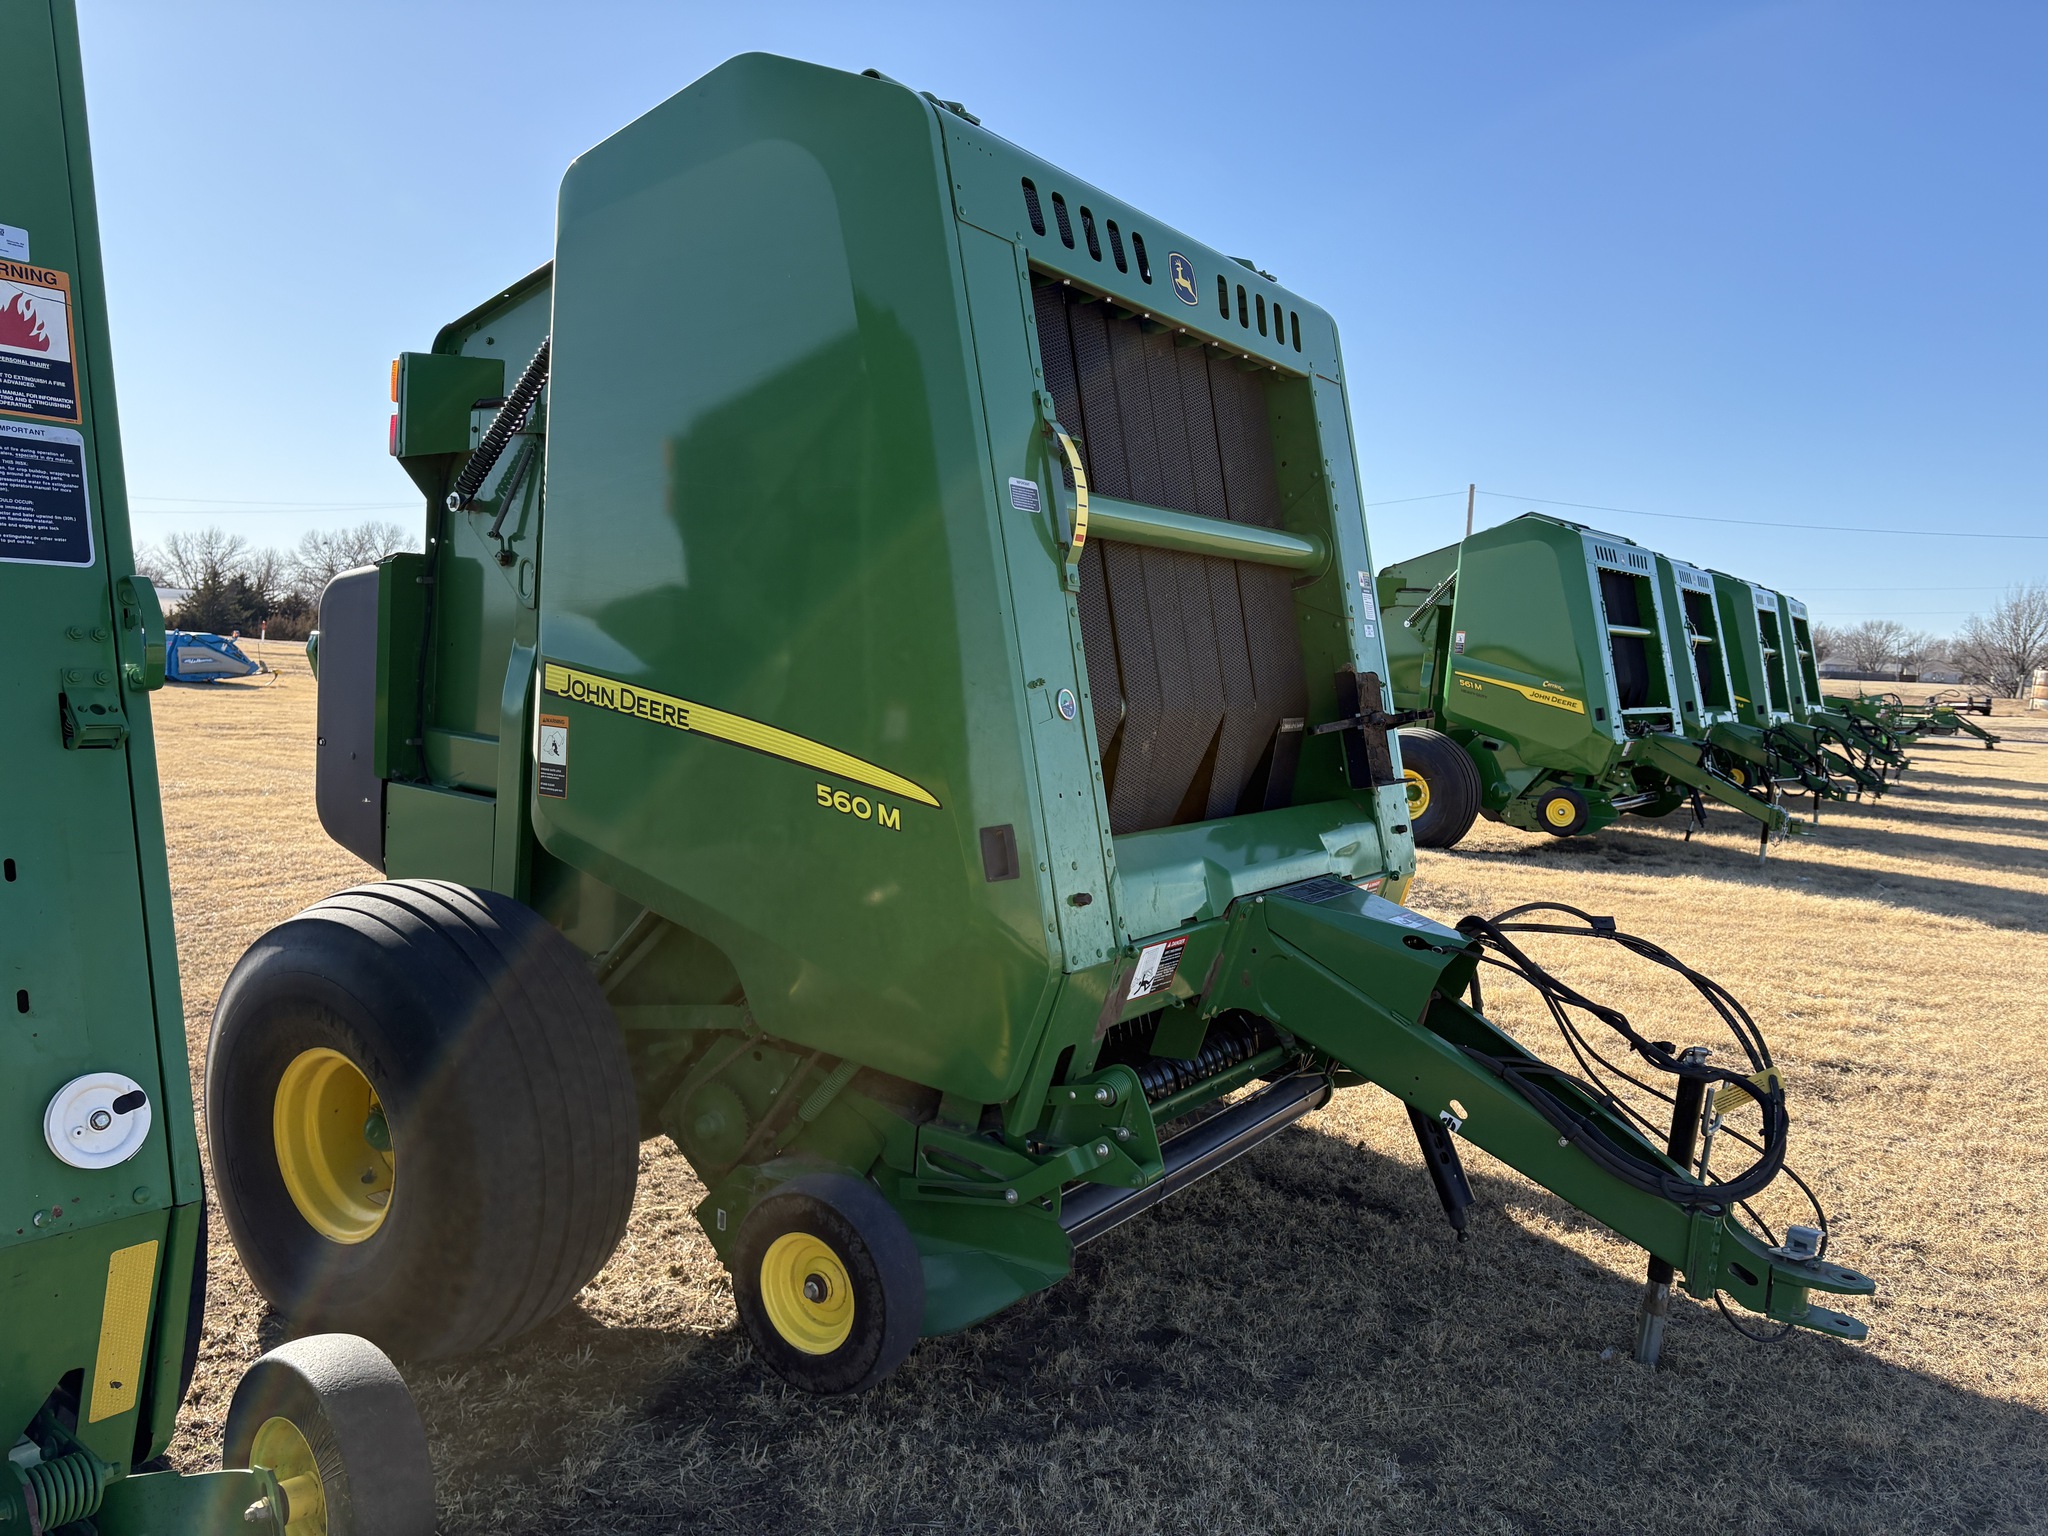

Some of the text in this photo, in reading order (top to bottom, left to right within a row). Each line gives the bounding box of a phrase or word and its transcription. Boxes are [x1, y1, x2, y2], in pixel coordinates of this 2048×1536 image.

[29, 361, 50, 369] INJURY
[13, 375, 47, 385] EXTINGUISH
[2, 390, 25, 398] MANUAL
[38, 395, 73, 405] INFORMATION
[28, 399, 71, 410] EXTINGUISHING
[560, 674, 690, 729] JOHN DEERE
[1529, 691, 1578, 709] JOHN DEERE
[816, 782, 901, 832] 560 M
